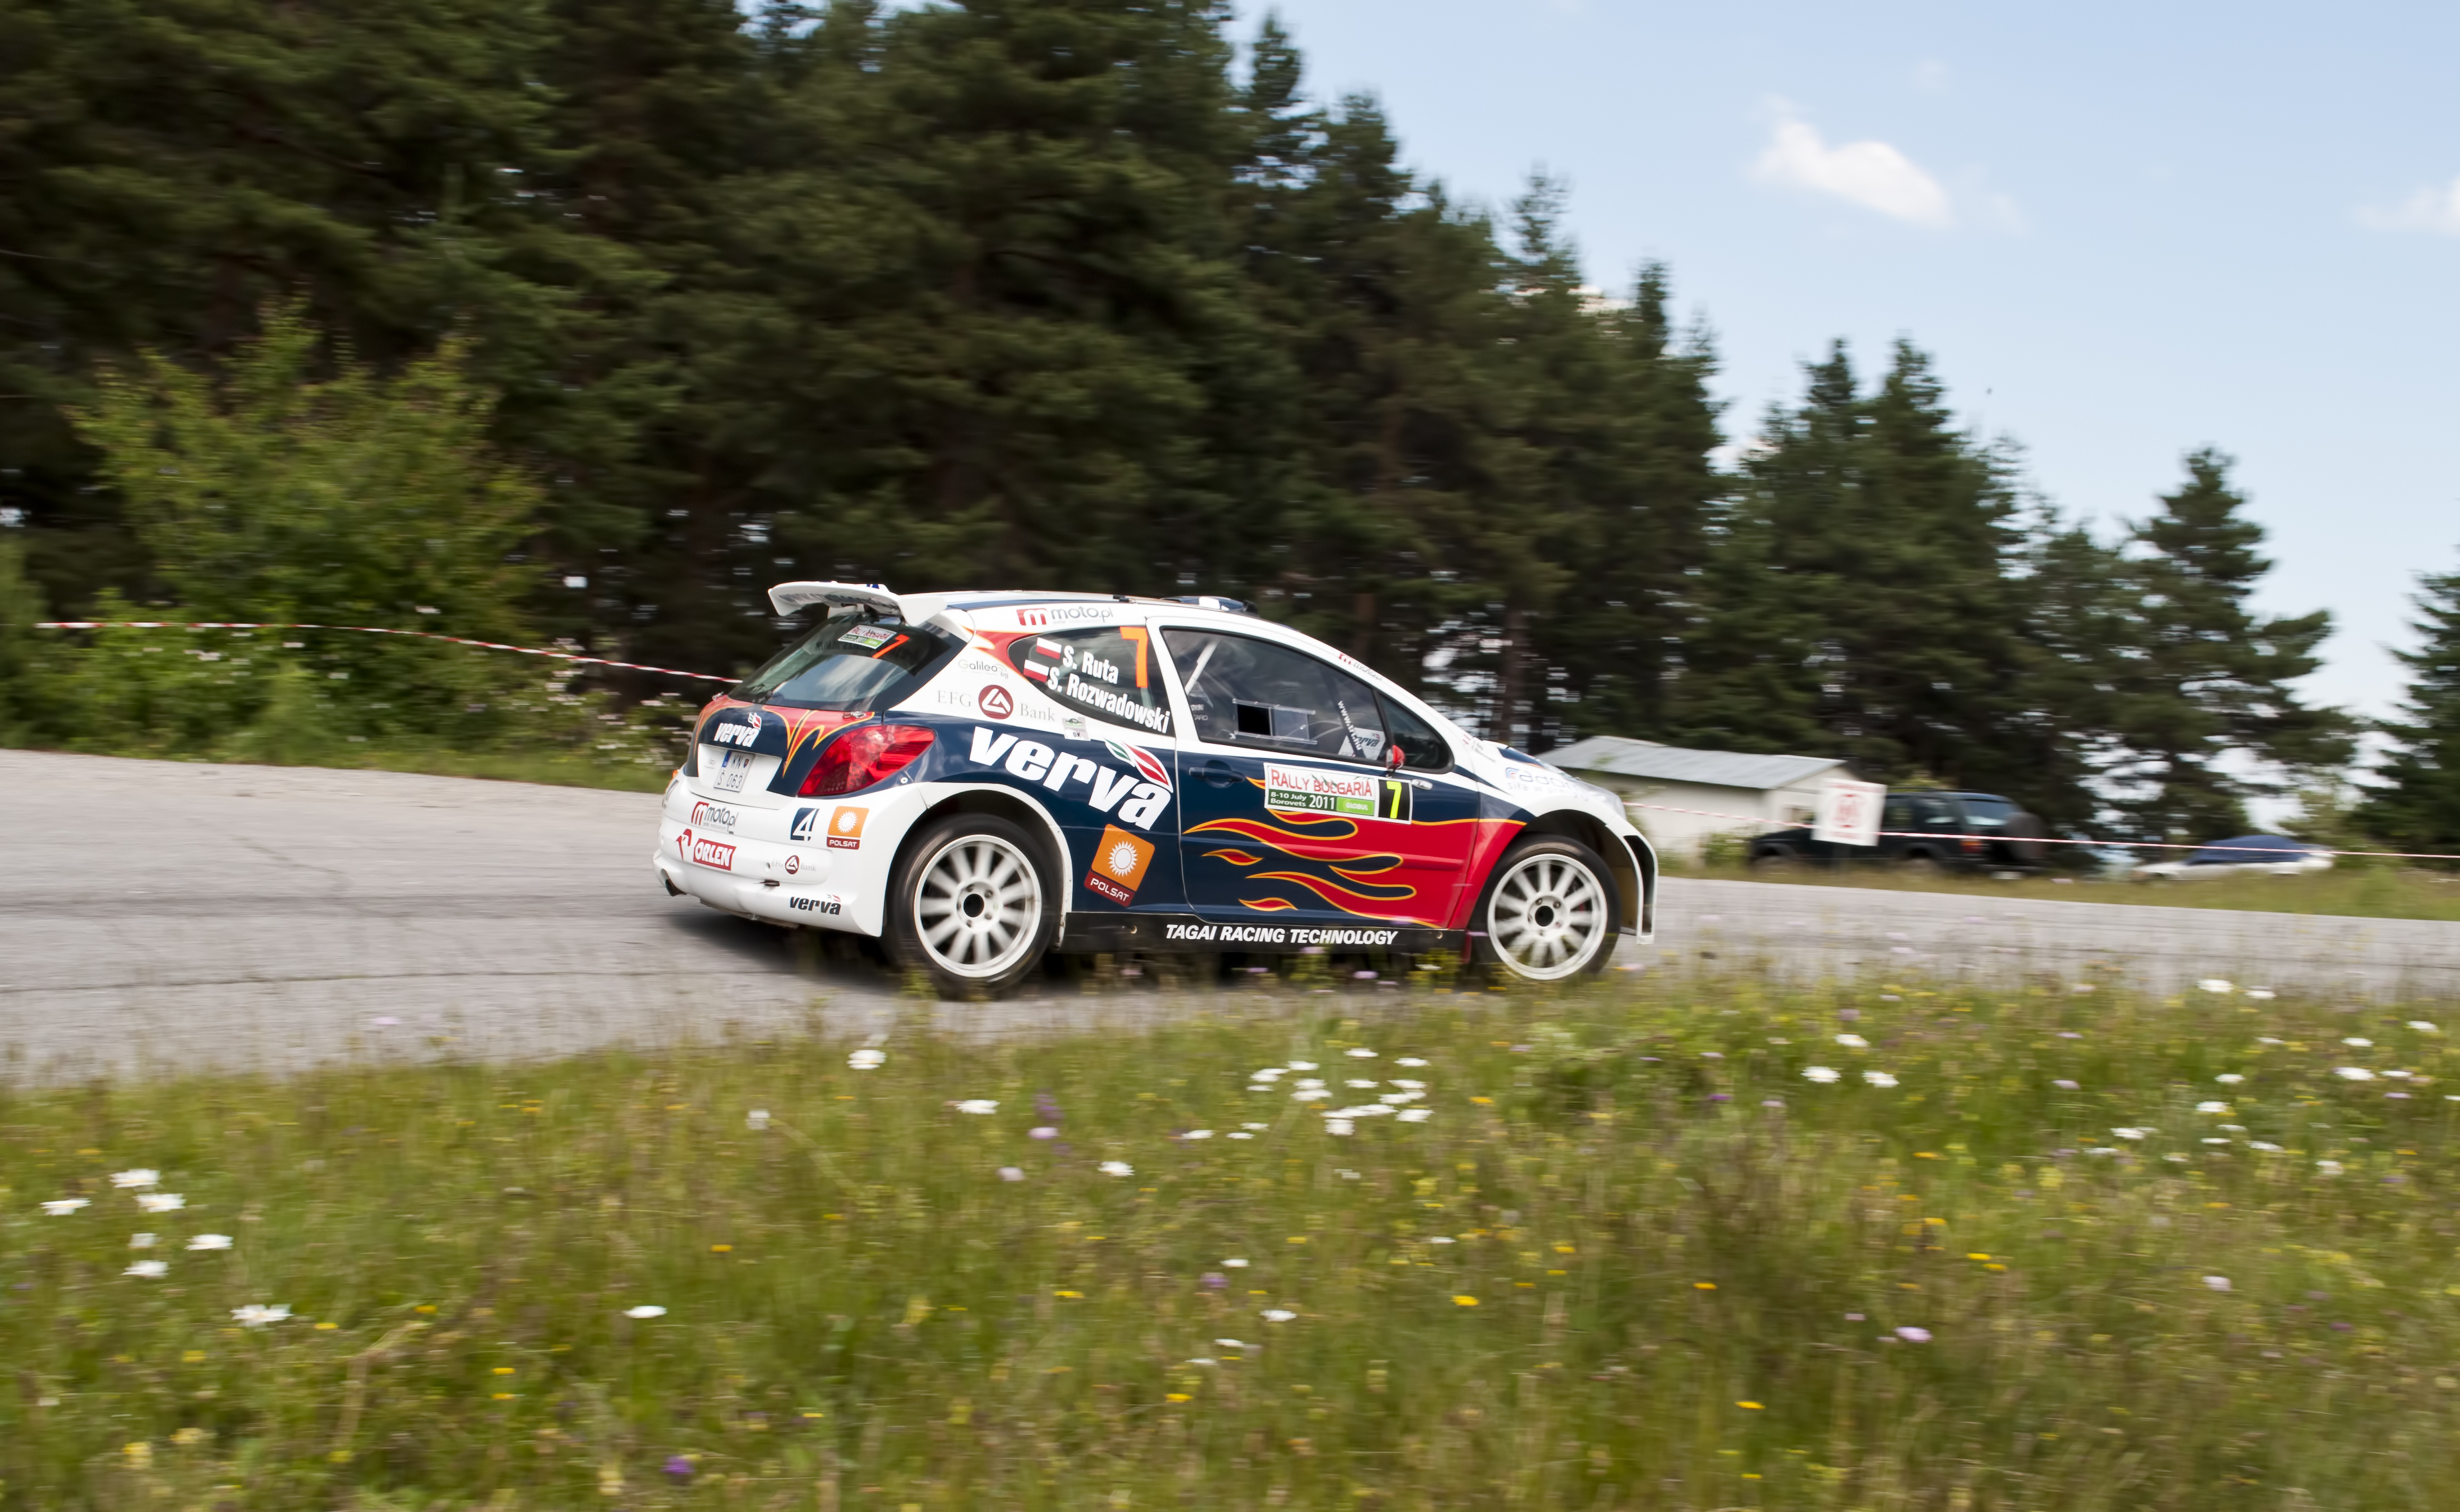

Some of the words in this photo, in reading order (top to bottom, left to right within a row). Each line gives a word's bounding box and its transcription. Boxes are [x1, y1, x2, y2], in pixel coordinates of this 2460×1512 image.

[1051, 606, 1113, 622] moto.pl
[959, 659, 997, 672] Galileo
[1063, 645, 1077, 669] S.
[1082, 651, 1119, 684] Ruta
[1120, 626, 1148, 688] 7
[937, 690, 972, 707] EFG
[1020, 703, 1056, 722] Bank
[1048, 667, 1063, 692] S.
[1066, 673, 1171, 734] Rozwadowski
[713, 723, 760, 748] verva
[969, 726, 1172, 831] verva
[1271, 769, 1311, 790] RALLY
[1314, 779, 1372, 796] BULGARIA
[1270, 798, 1307, 807] Borovets
[1309, 795, 1335, 810] 2011
[1386, 781, 1403, 819] 7
[704, 807, 739, 832] moto.pl
[695, 841, 733, 867] ORLEN
[829, 839, 857, 848] POLSAT
[801, 862, 817, 872] Bank
[1090, 877, 1129, 902] POLSAT
[790, 896, 842, 915] verva
[1165, 924, 1217, 940] TAGAI
[1220, 926, 1286, 942] RACING
[1289, 929, 1399, 944] TECHNOLOGY
